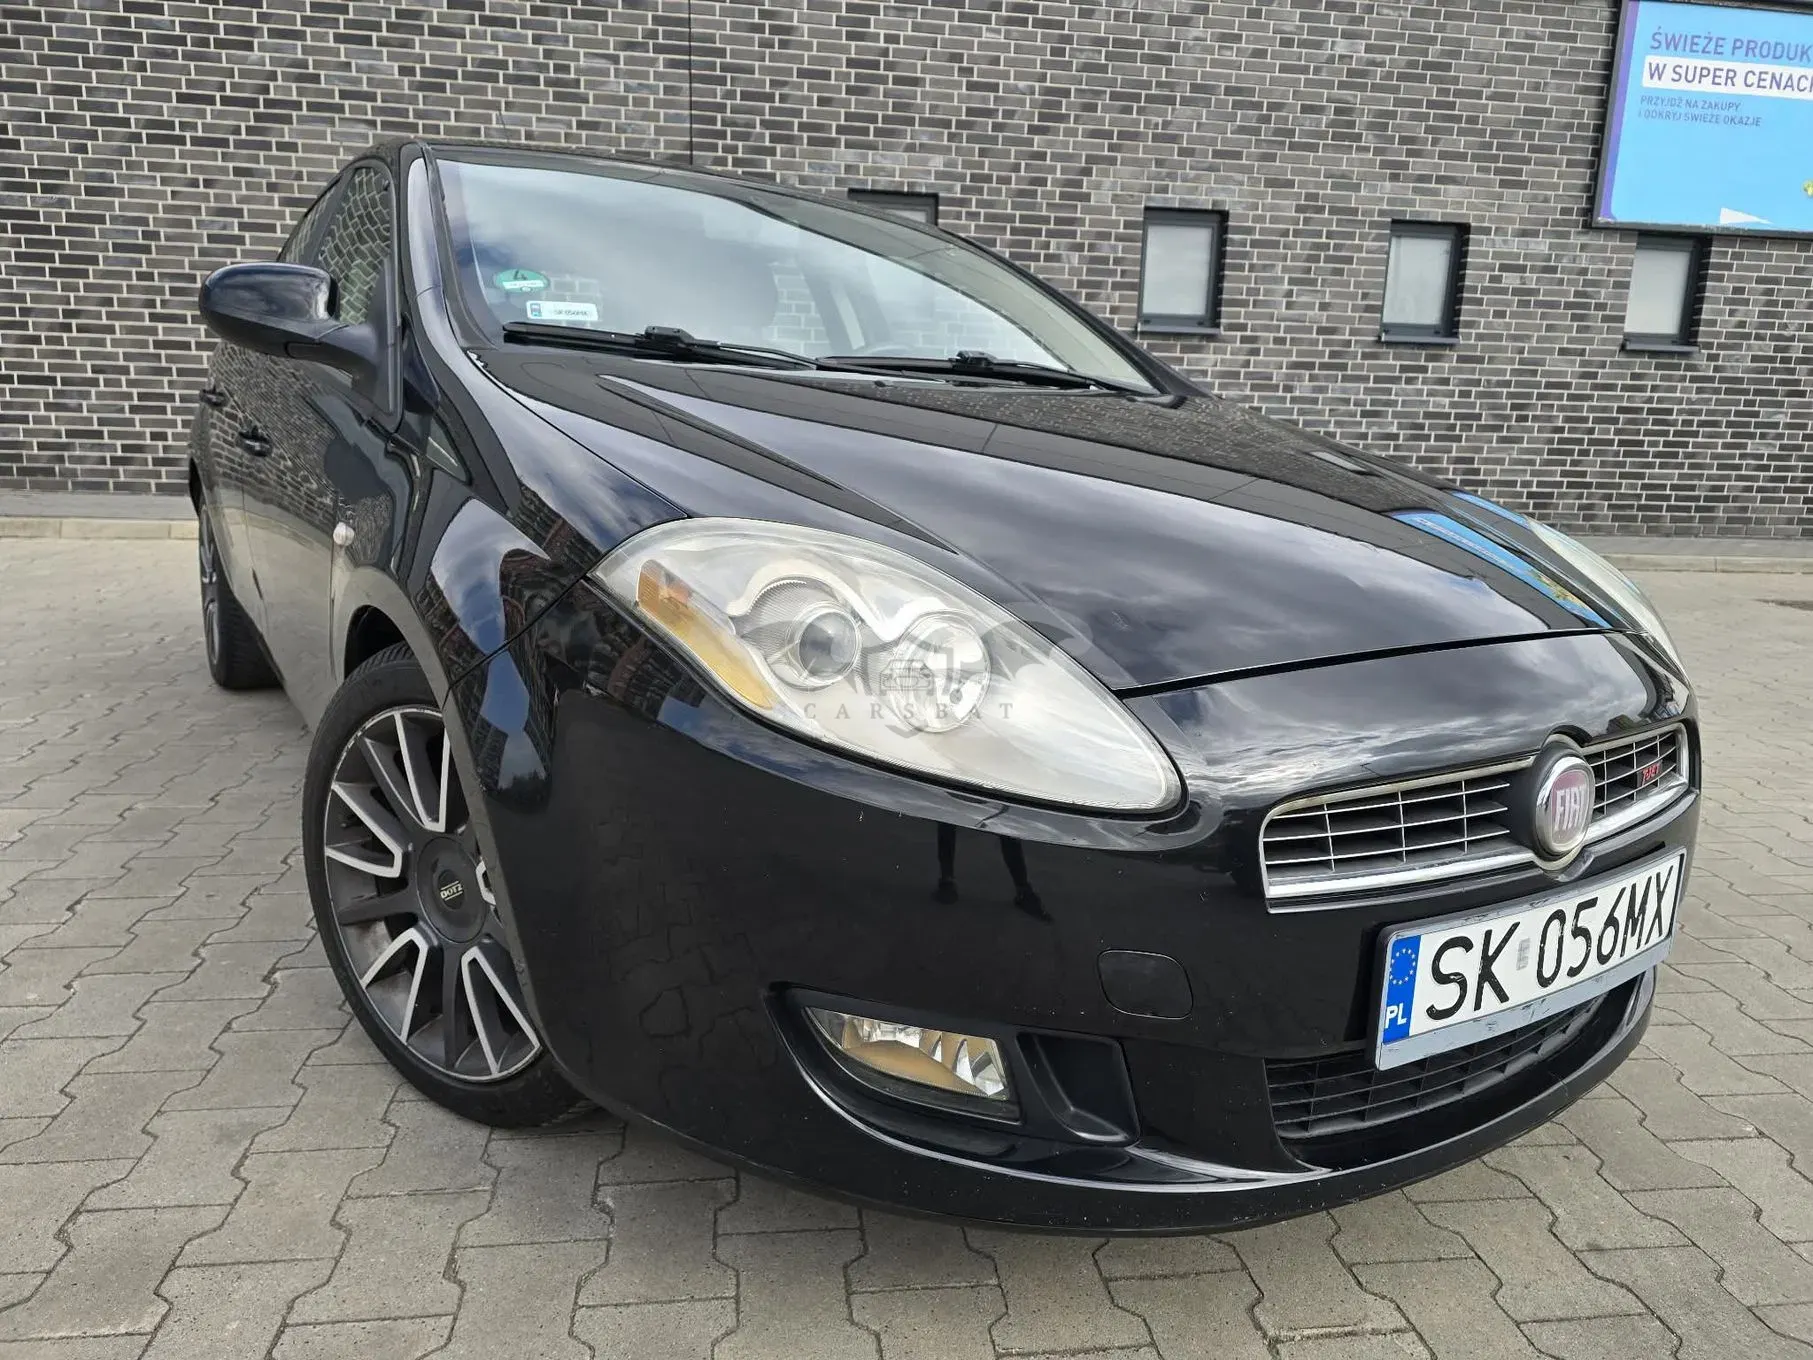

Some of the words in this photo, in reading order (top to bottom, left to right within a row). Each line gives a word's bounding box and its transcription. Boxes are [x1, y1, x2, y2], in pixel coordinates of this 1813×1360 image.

[1650, 26, 1727, 56] ŚWIEŻE
[1648, 62, 1667, 82] W
[1671, 64, 1737, 87] SUPER
[1554, 784, 1588, 831] FIAT
[440, 883, 463, 899] DOTZ
[1425, 921, 1521, 1021] SK
[1536, 864, 1674, 988] 056MX
[1384, 1003, 1407, 1029] PL
